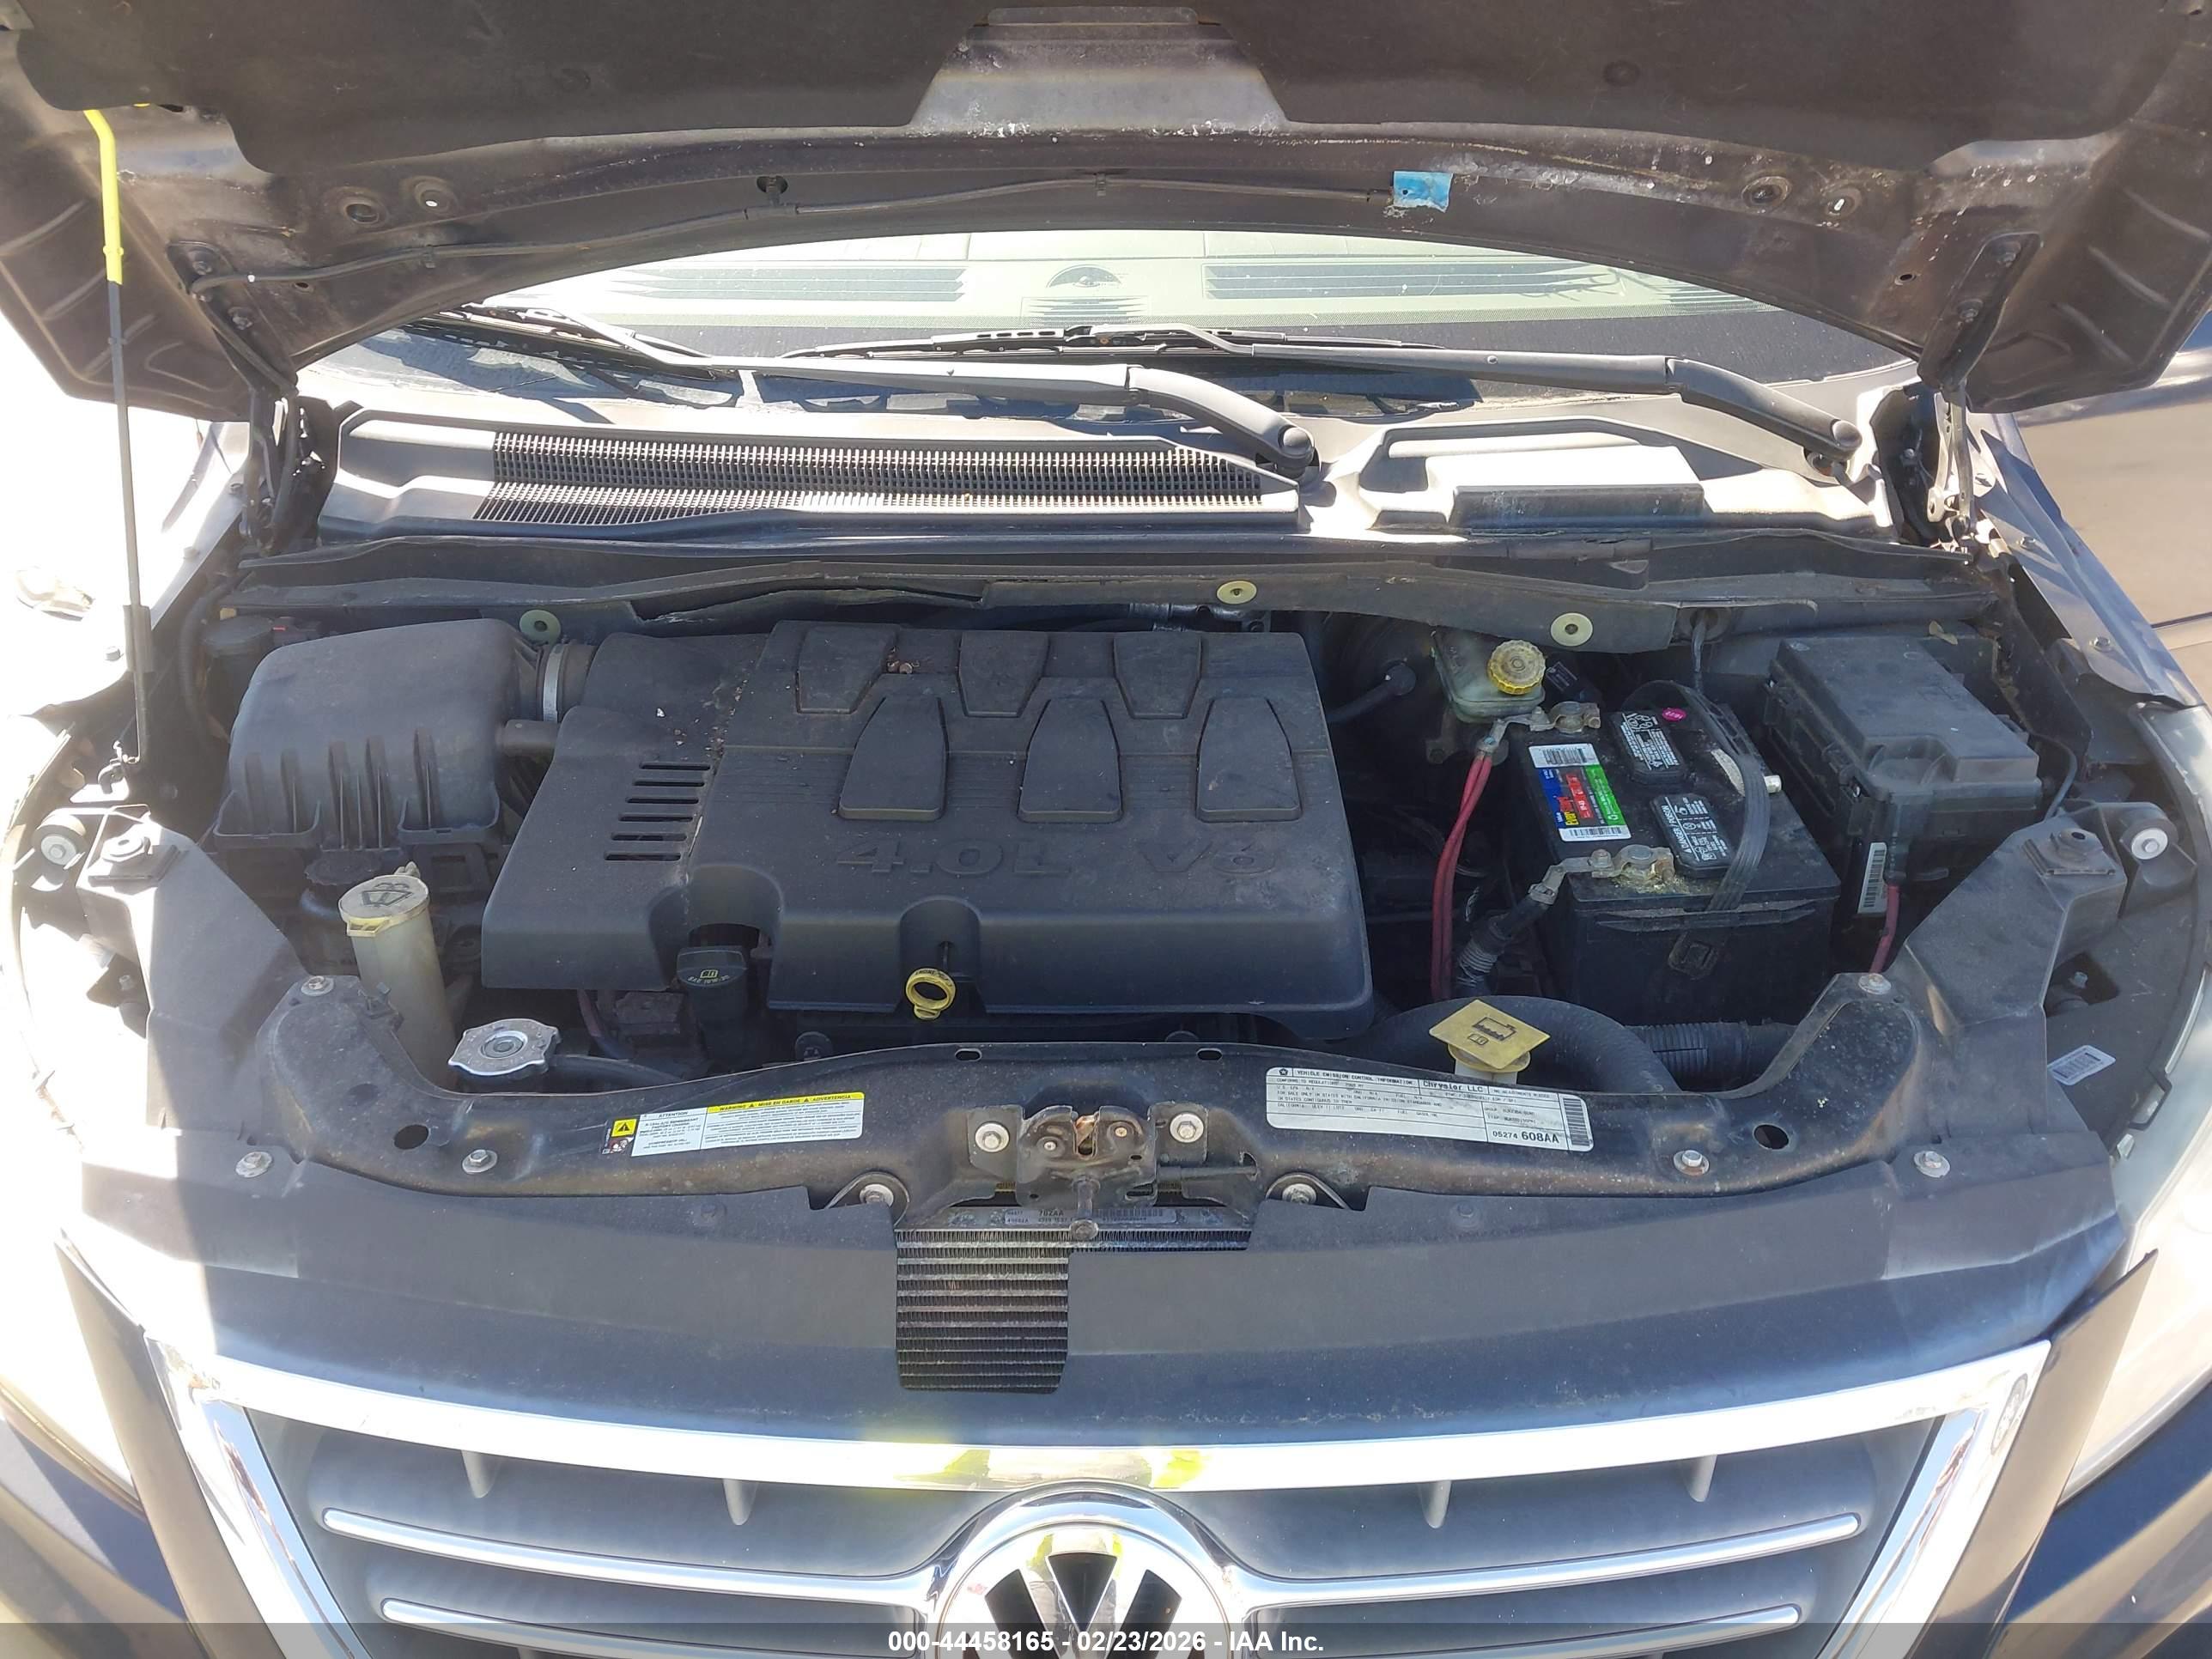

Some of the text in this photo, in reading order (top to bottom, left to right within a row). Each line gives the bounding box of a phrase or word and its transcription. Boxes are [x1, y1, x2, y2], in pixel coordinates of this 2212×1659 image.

[1423, 1080, 1462, 1091] Chrysler
[1492, 1130, 1560, 1144] 05274 608AA
